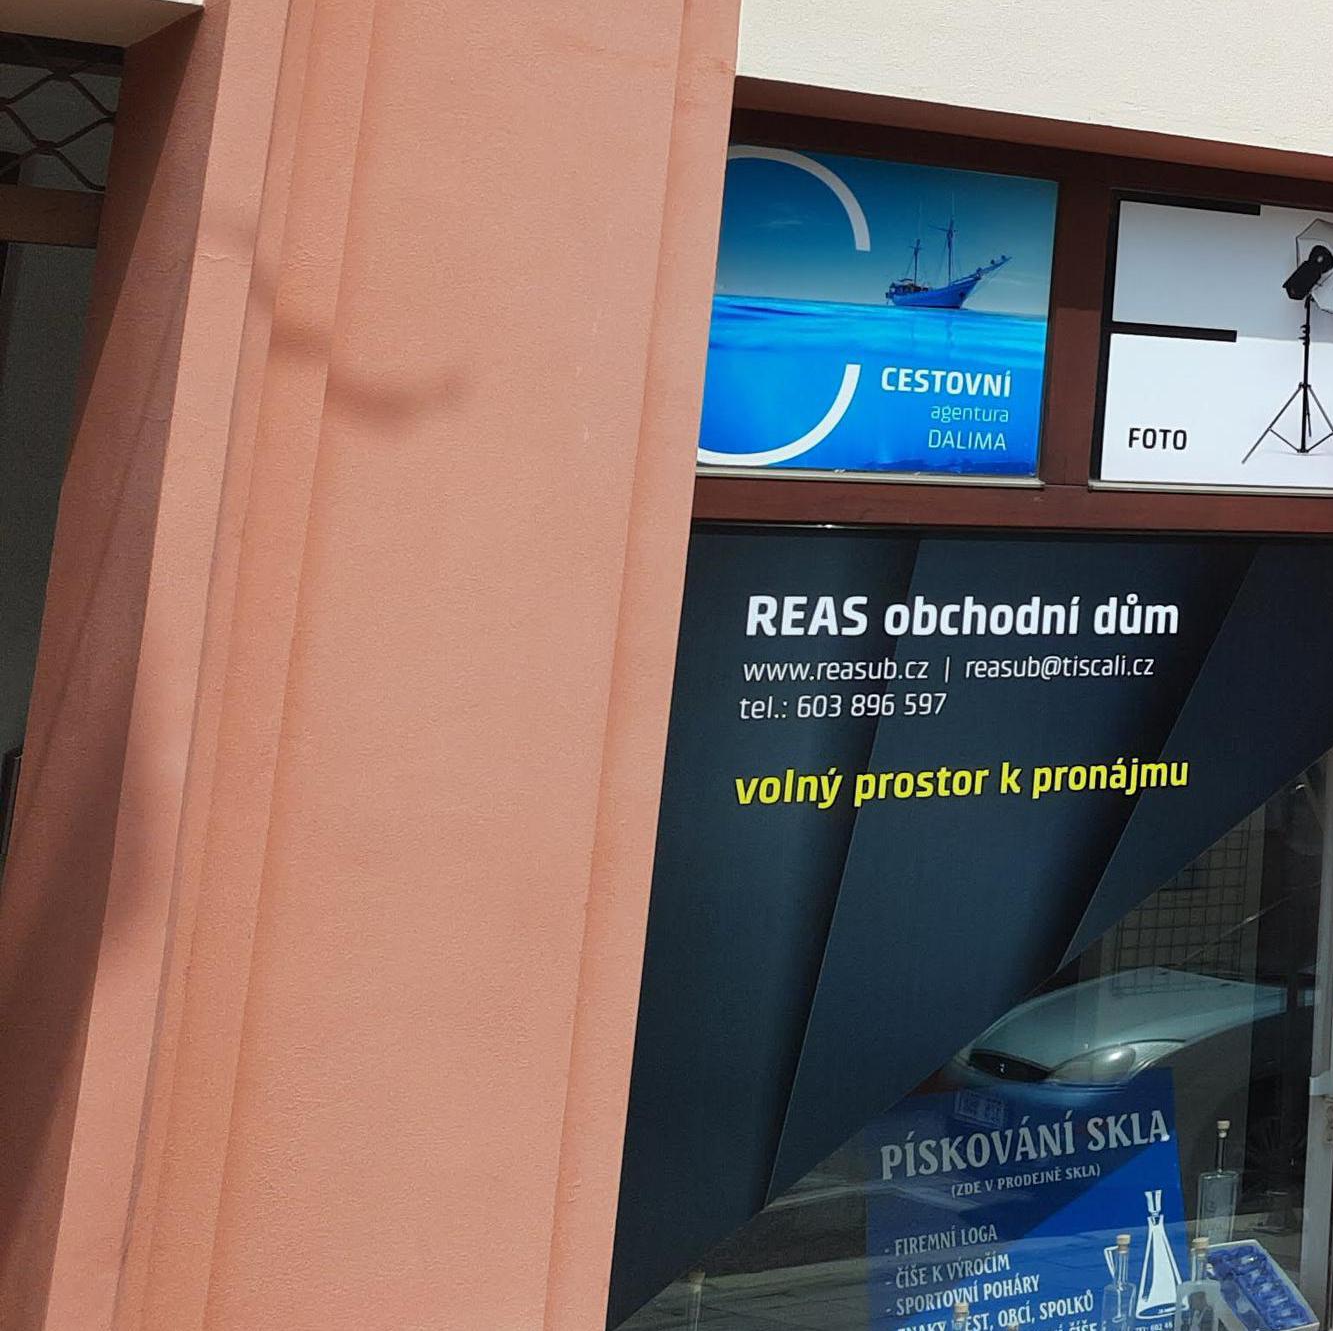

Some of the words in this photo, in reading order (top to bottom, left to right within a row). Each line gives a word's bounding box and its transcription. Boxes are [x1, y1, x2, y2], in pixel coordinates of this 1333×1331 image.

[881, 367, 1011, 398] CESTOVNÍ
[930, 405, 1009, 423] agentura
[928, 429, 1007, 451] DALIMA
[1128, 427, 1188, 450] FOTO
[745, 596, 868, 636] REAS
[884, 596, 1080, 636] obchodní
[1093, 594, 1179, 635] dům
[743, 657, 928, 682] www.reasub.cz
[965, 655, 1154, 681] reasub@tiscali.cz
[739, 696, 788, 720] tel.:
[796, 694, 842, 718] 603
[850, 693, 895, 717] 896
[904, 692, 947, 715] 597
[735, 767, 842, 808] volný
[854, 766, 990, 807] prostor
[1000, 762, 1021, 794] k
[1032, 757, 1189, 799] pronájmu
[880, 1110, 1076, 1180] PÍSKOVÁNÍ
[1086, 1109, 1171, 1153] SKLA
[951, 1181, 983, 1200] (ZDE
[985, 1179, 995, 1193] V
[997, 1169, 1063, 1191] PRODEJNĚ
[1065, 1164, 1101, 1182] SKLA)
[895, 1225, 956, 1257] FIREMNÍ
[960, 1224, 998, 1246] LOGA
[896, 1264, 928, 1289] ČÍŠE
[932, 1266, 943, 1283] K
[946, 1251, 1011, 1281] VÝROČÍM
[896, 1280, 979, 1316] SPORTOVNÍ
[983, 1273, 1040, 1301] POHÁRY
[998, 1300, 1036, 1327] OBCÍ,
[1039, 1289, 1094, 1321] SPOLKŮ
